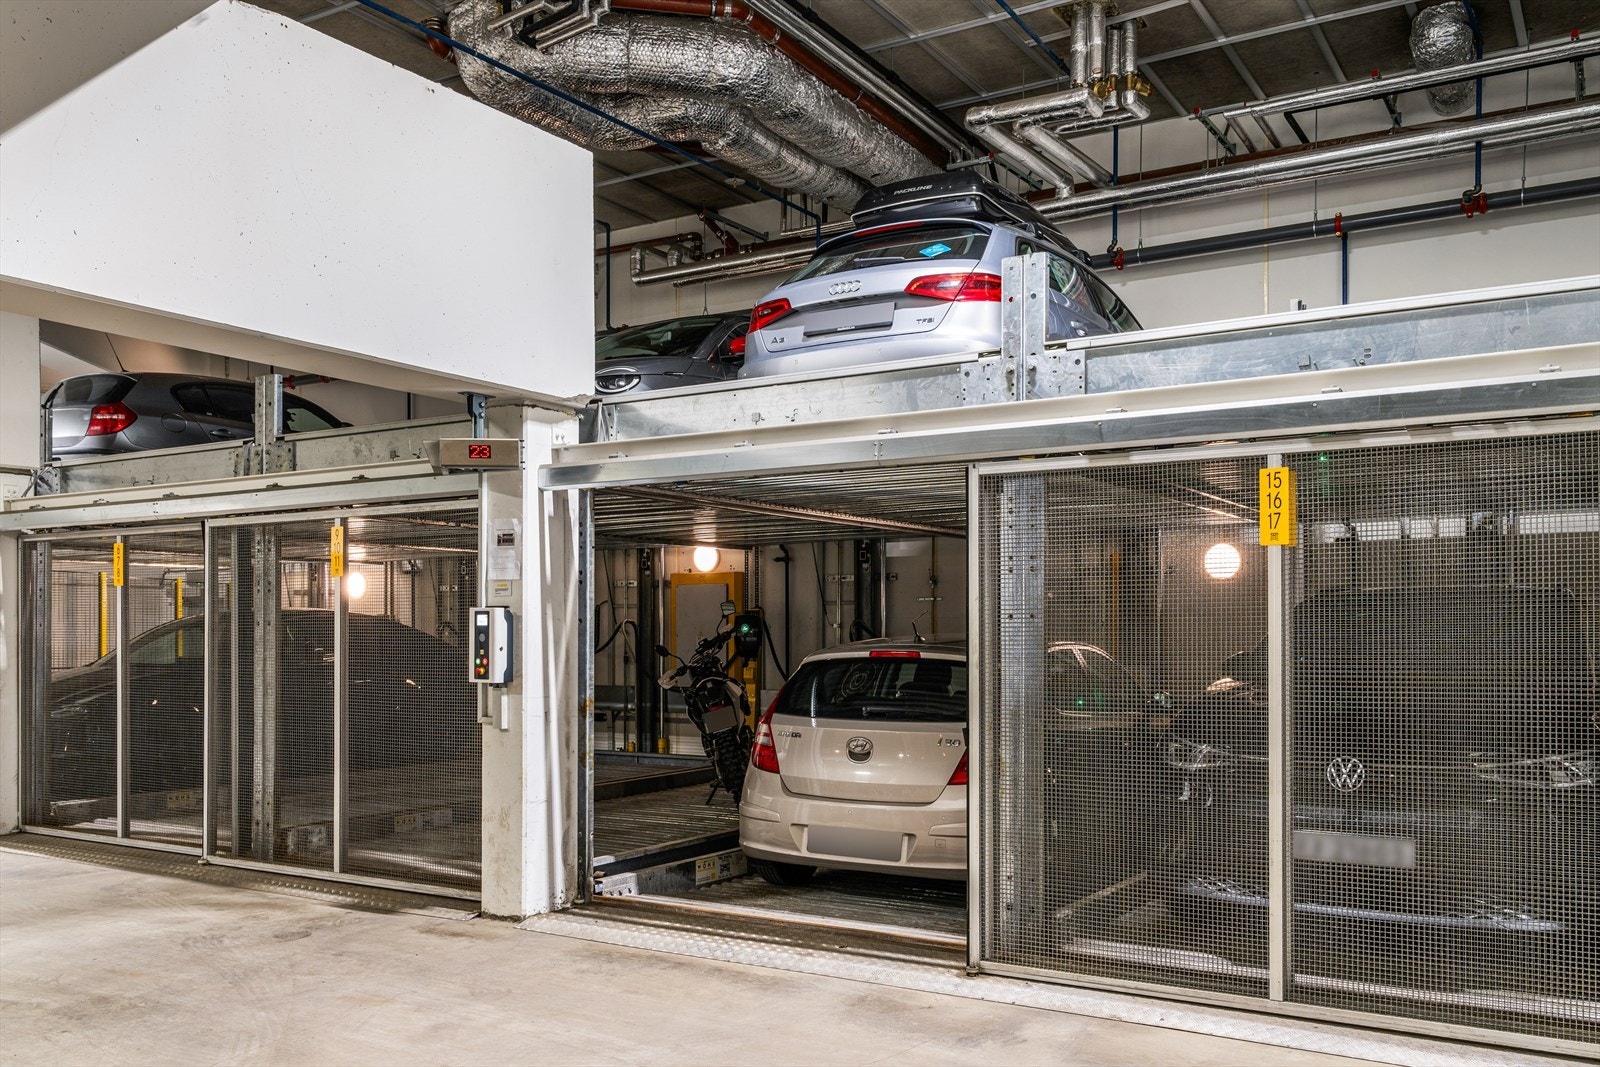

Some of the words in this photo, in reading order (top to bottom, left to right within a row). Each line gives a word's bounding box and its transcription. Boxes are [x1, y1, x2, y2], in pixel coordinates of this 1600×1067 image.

[893, 184, 933, 195] PACKLINE
[470, 445, 490, 458] 23
[1266, 471, 1282, 489] 15
[1266, 491, 1282, 509] 16
[1268, 512, 1282, 530] 17
[335, 529, 340, 541] 9
[334, 542, 341, 553] 10
[334, 555, 340, 567] 11
